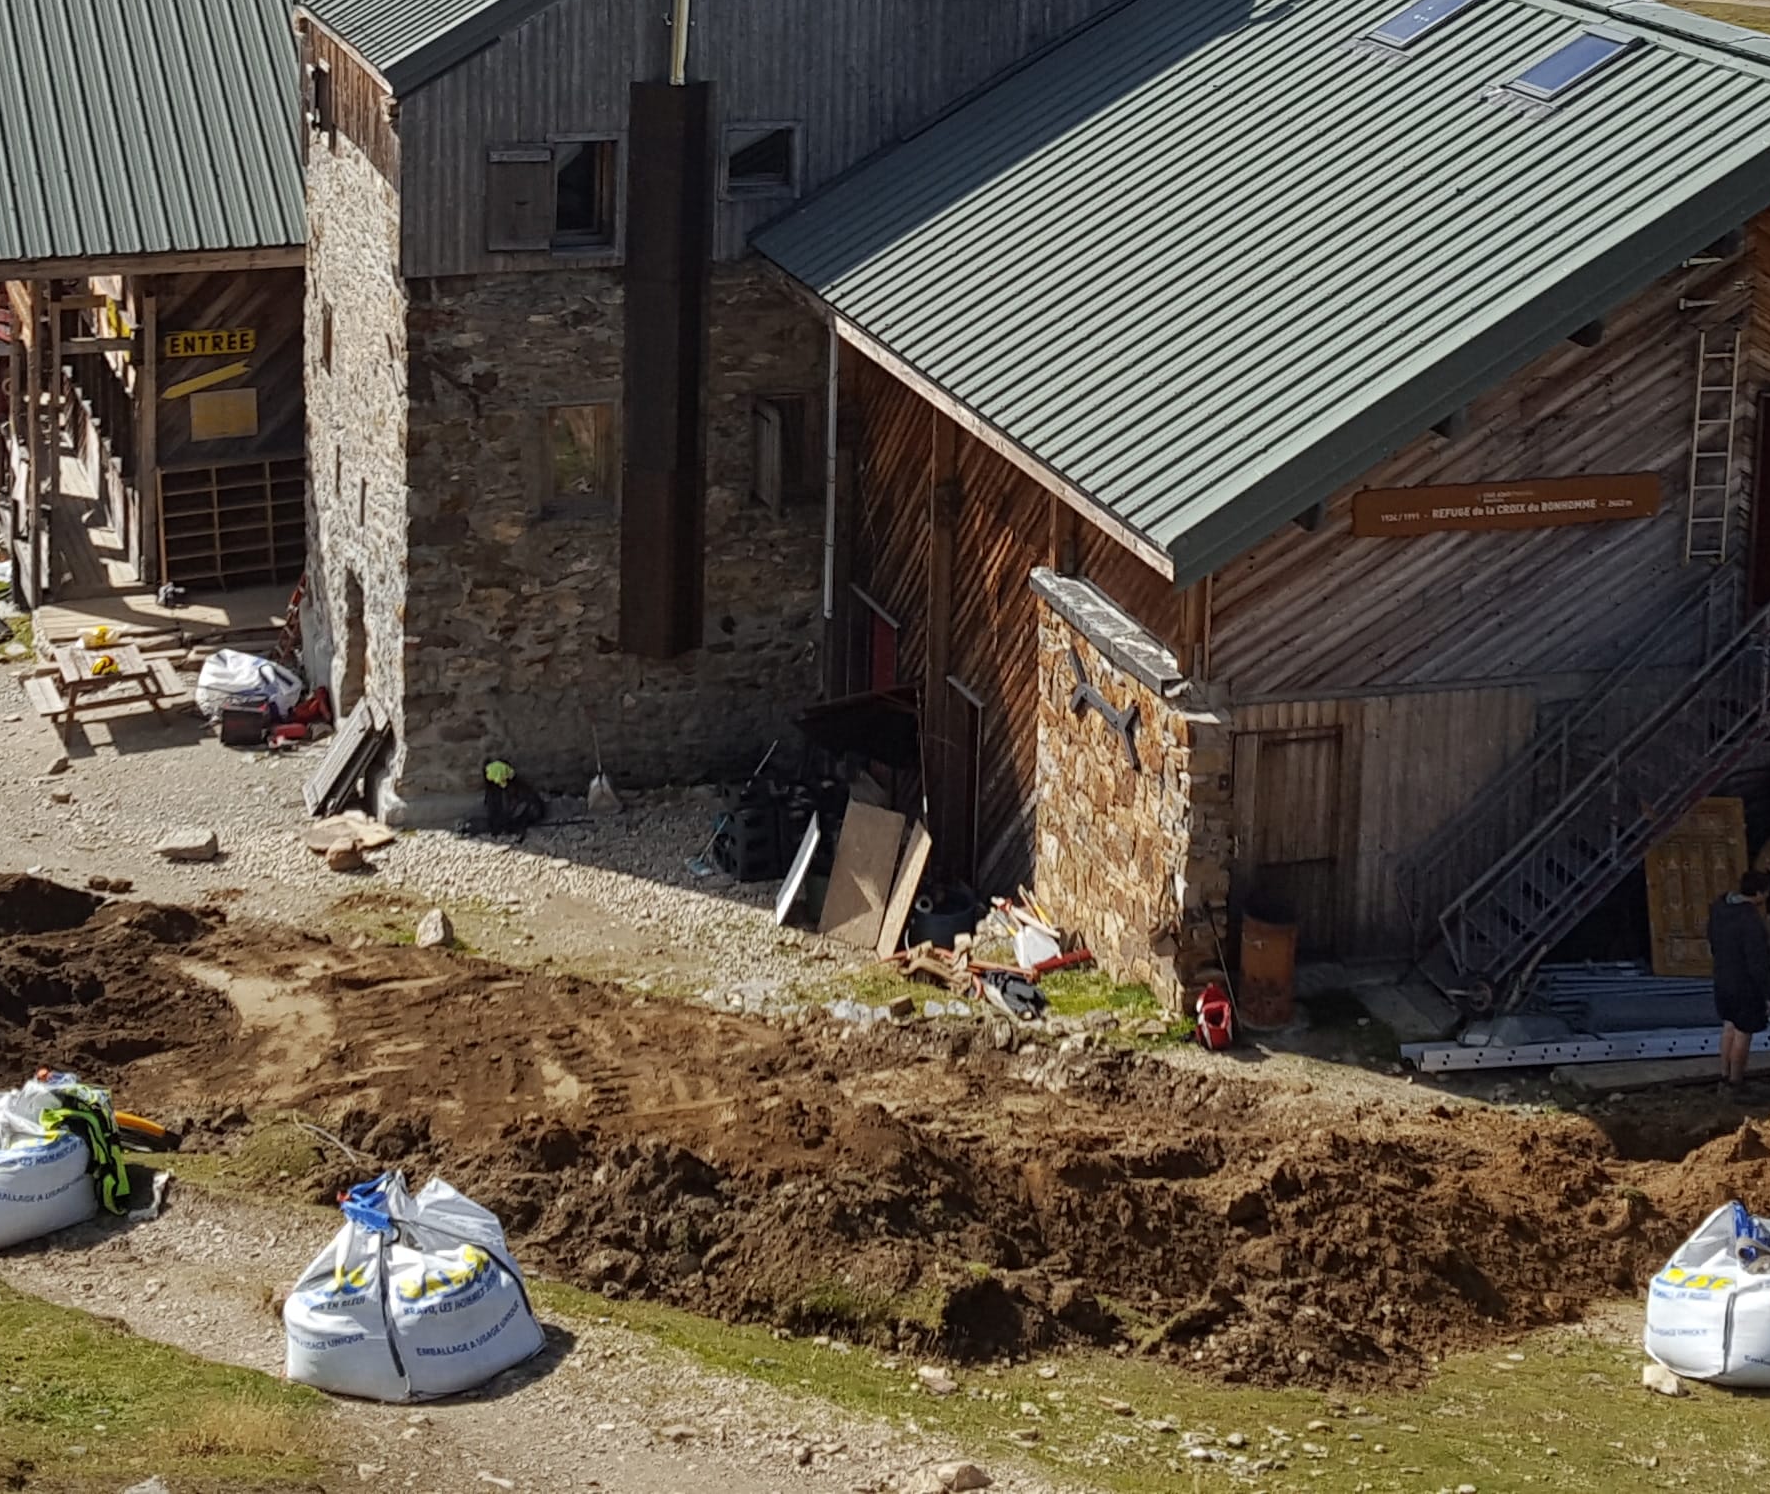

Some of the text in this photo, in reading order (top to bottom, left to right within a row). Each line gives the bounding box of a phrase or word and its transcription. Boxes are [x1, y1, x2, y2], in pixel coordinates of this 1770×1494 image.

[169, 333, 250, 354] ENTREE
[1431, 506, 1471, 519] REFUGE
[1472, 506, 1484, 516] de
[1485, 505, 1495, 515] la
[1496, 503, 1526, 515] CROIX
[1541, 498, 1598, 512] BONHOMME
[327, 1332, 365, 1348] UNIQUE
[416, 1343, 470, 1357] EMBALLAGE
